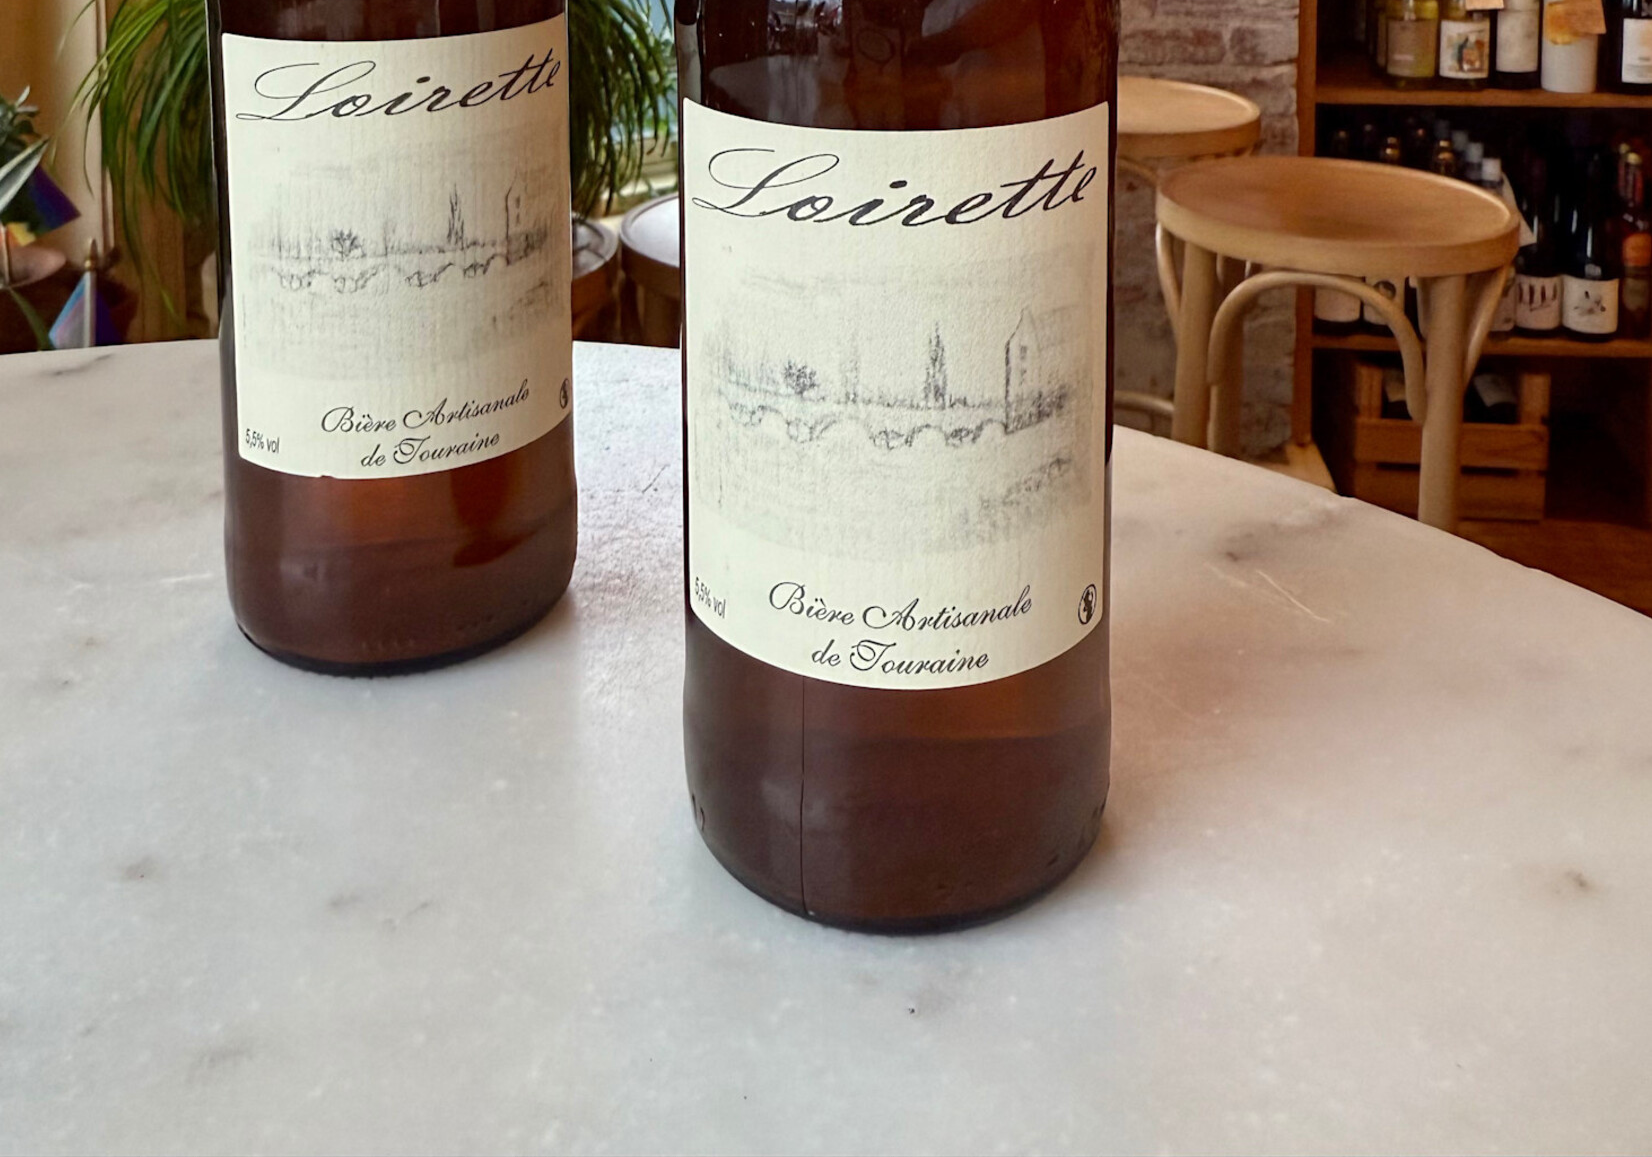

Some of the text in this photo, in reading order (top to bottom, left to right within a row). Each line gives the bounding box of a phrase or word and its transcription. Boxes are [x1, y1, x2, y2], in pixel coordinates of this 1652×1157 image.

[236, 47, 562, 121] Loirette
[692, 149, 1097, 227] Loirette
[320, 378, 530, 434] Bière Artisanale
[266, 437, 280, 454] vol
[360, 431, 500, 468] de Touraine
[713, 597, 727, 619] vol
[768, 581, 1033, 632] Bière Artisanale
[811, 639, 990, 675] de Touraine
